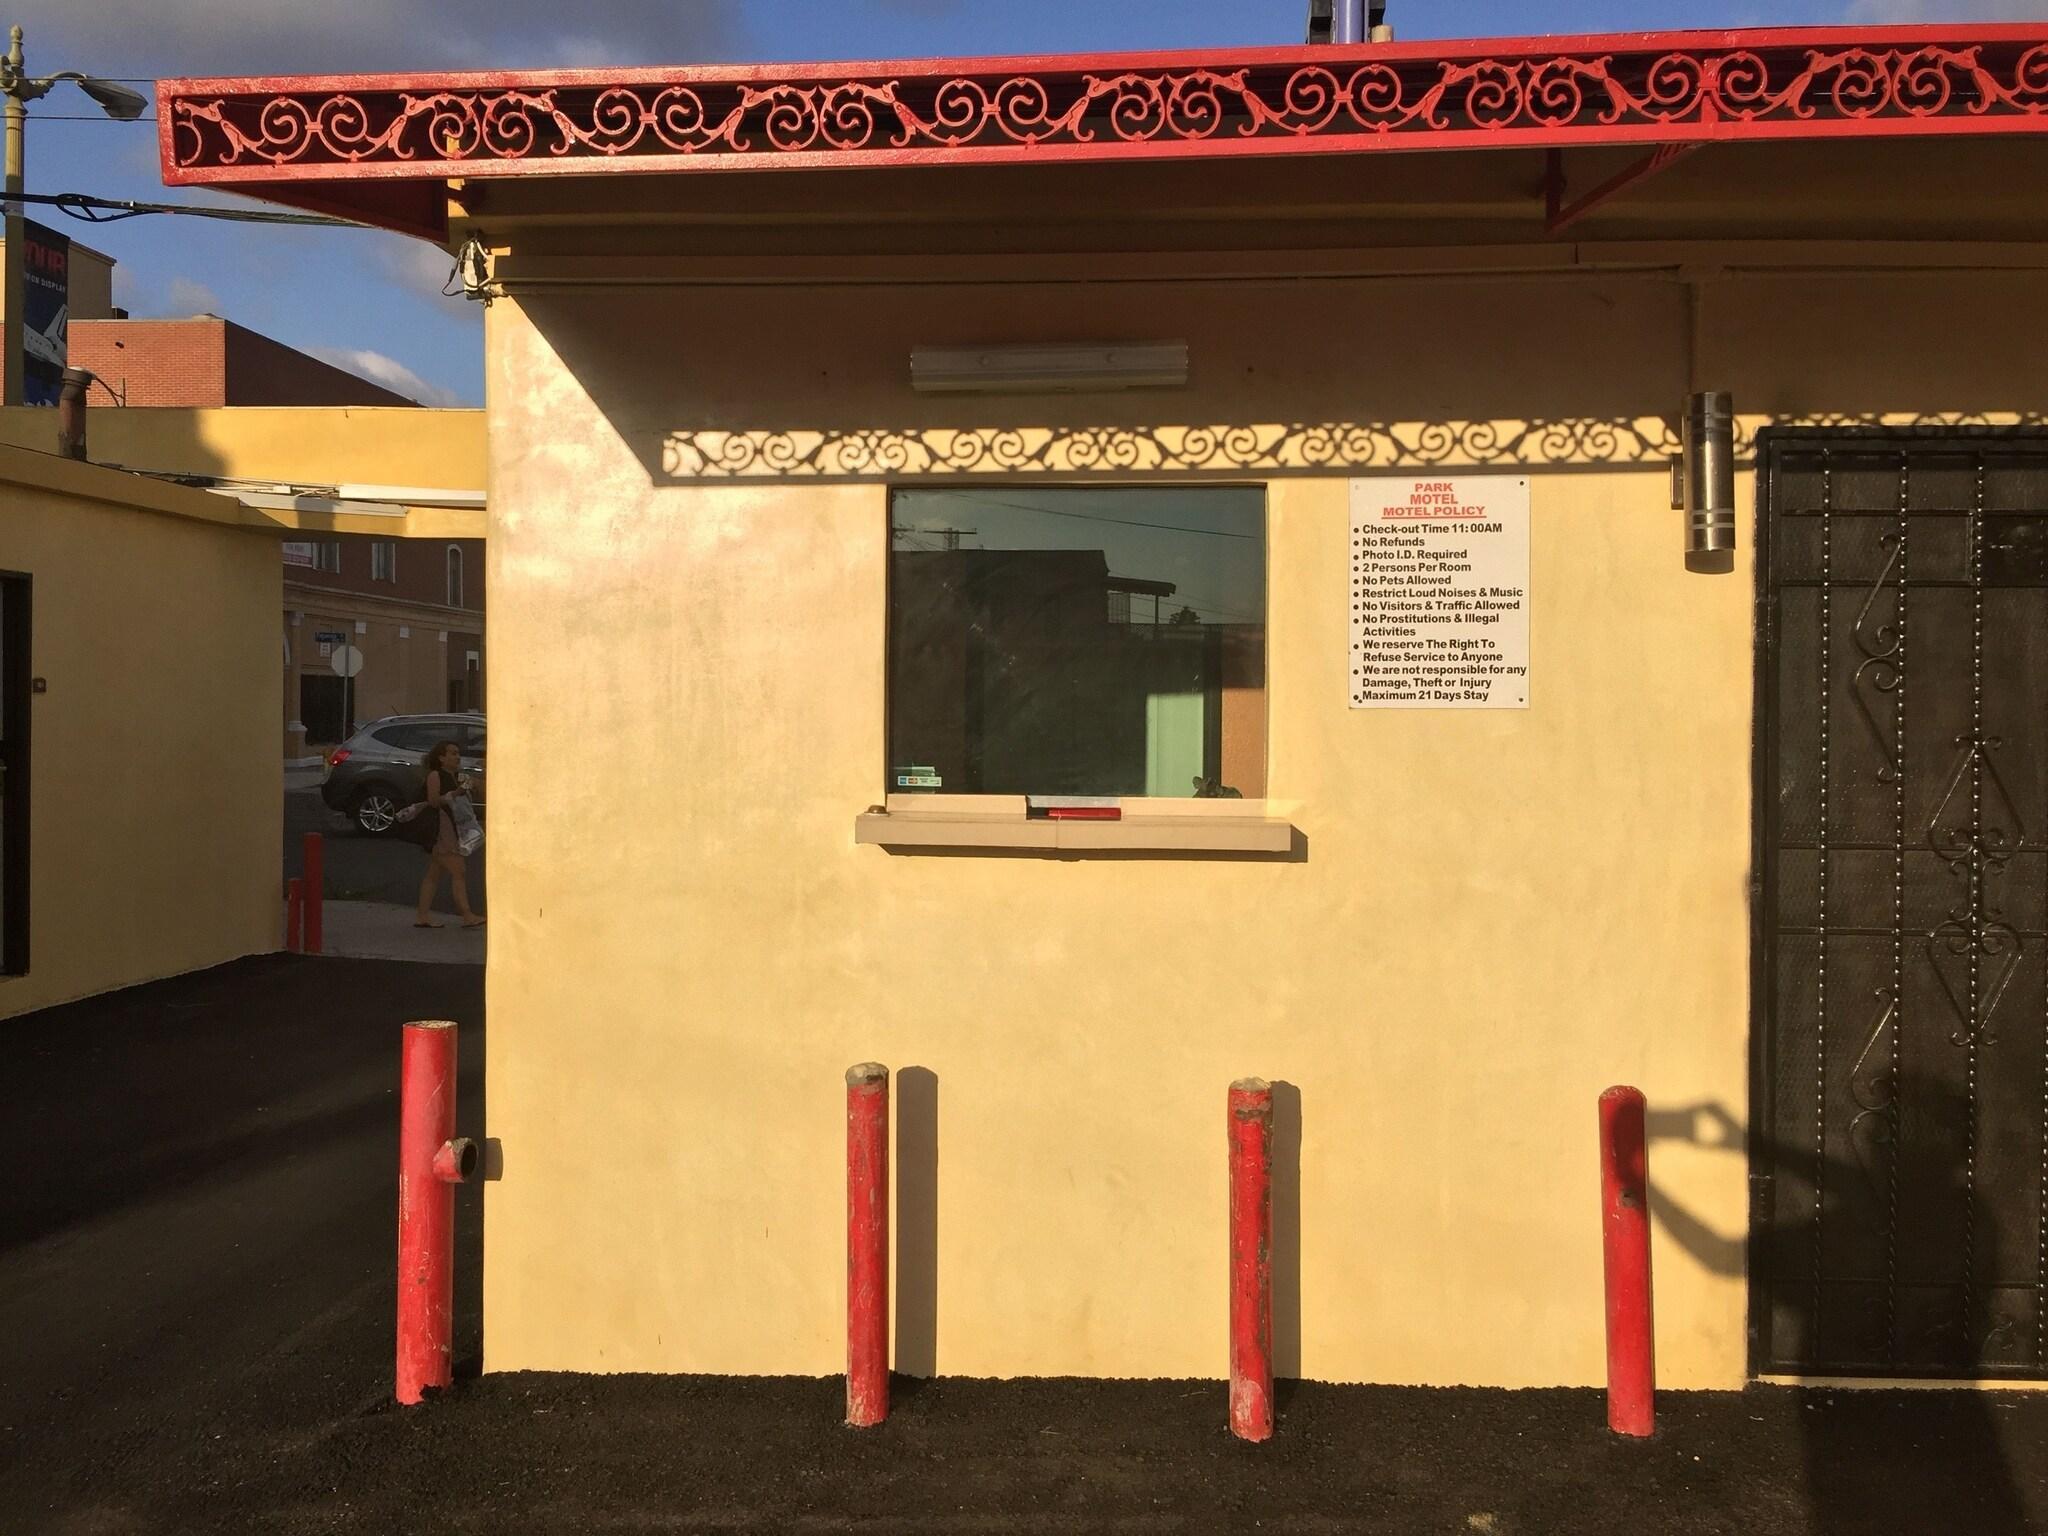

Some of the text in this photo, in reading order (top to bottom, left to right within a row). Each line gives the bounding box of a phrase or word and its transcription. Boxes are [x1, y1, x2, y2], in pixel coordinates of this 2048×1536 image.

[1415, 483, 1453, 491] PARK
[1410, 494, 1458, 504] MOTEL
[1383, 506, 1485, 516] MOTEL POLICY
[1363, 523, 1502, 534] Check-out Time 11:00AM
[1363, 538, 1425, 546] No Refunds
[1363, 550, 1467, 560] Photo I.D. Required
[1363, 563, 1471, 572] 2 Persons Per Room
[1363, 576, 1451, 585] No Pets Allowed
[1363, 588, 1523, 598] Restrict Loud Noises & Music
[1363, 601, 1520, 610] No Visitors & Traffic Allowed
[1363, 614, 1499, 624] No Prostitutions & Illegal
[1363, 627, 1416, 636] Activities
[1363, 640, 1380, 649] We
[1426, 640, 1447, 648] The
[1449, 639, 1479, 650] Right
[1481, 639, 1495, 648] To
[1363, 652, 1503, 663] Refuse Service to Anyone
[1363, 666, 1380, 674] We
[1403, 666, 1420, 674] not
[1422, 665, 1487, 676] responsible
[1489, 665, 1505, 674] for
[1507, 667, 1526, 676] any
[1363, 678, 1411, 689] Damage,
[1413, 678, 1443, 687] Theft
[1460, 678, 1492, 689] Injury
[1363, 690, 1488, 702] Maximum 21 Days Stay
